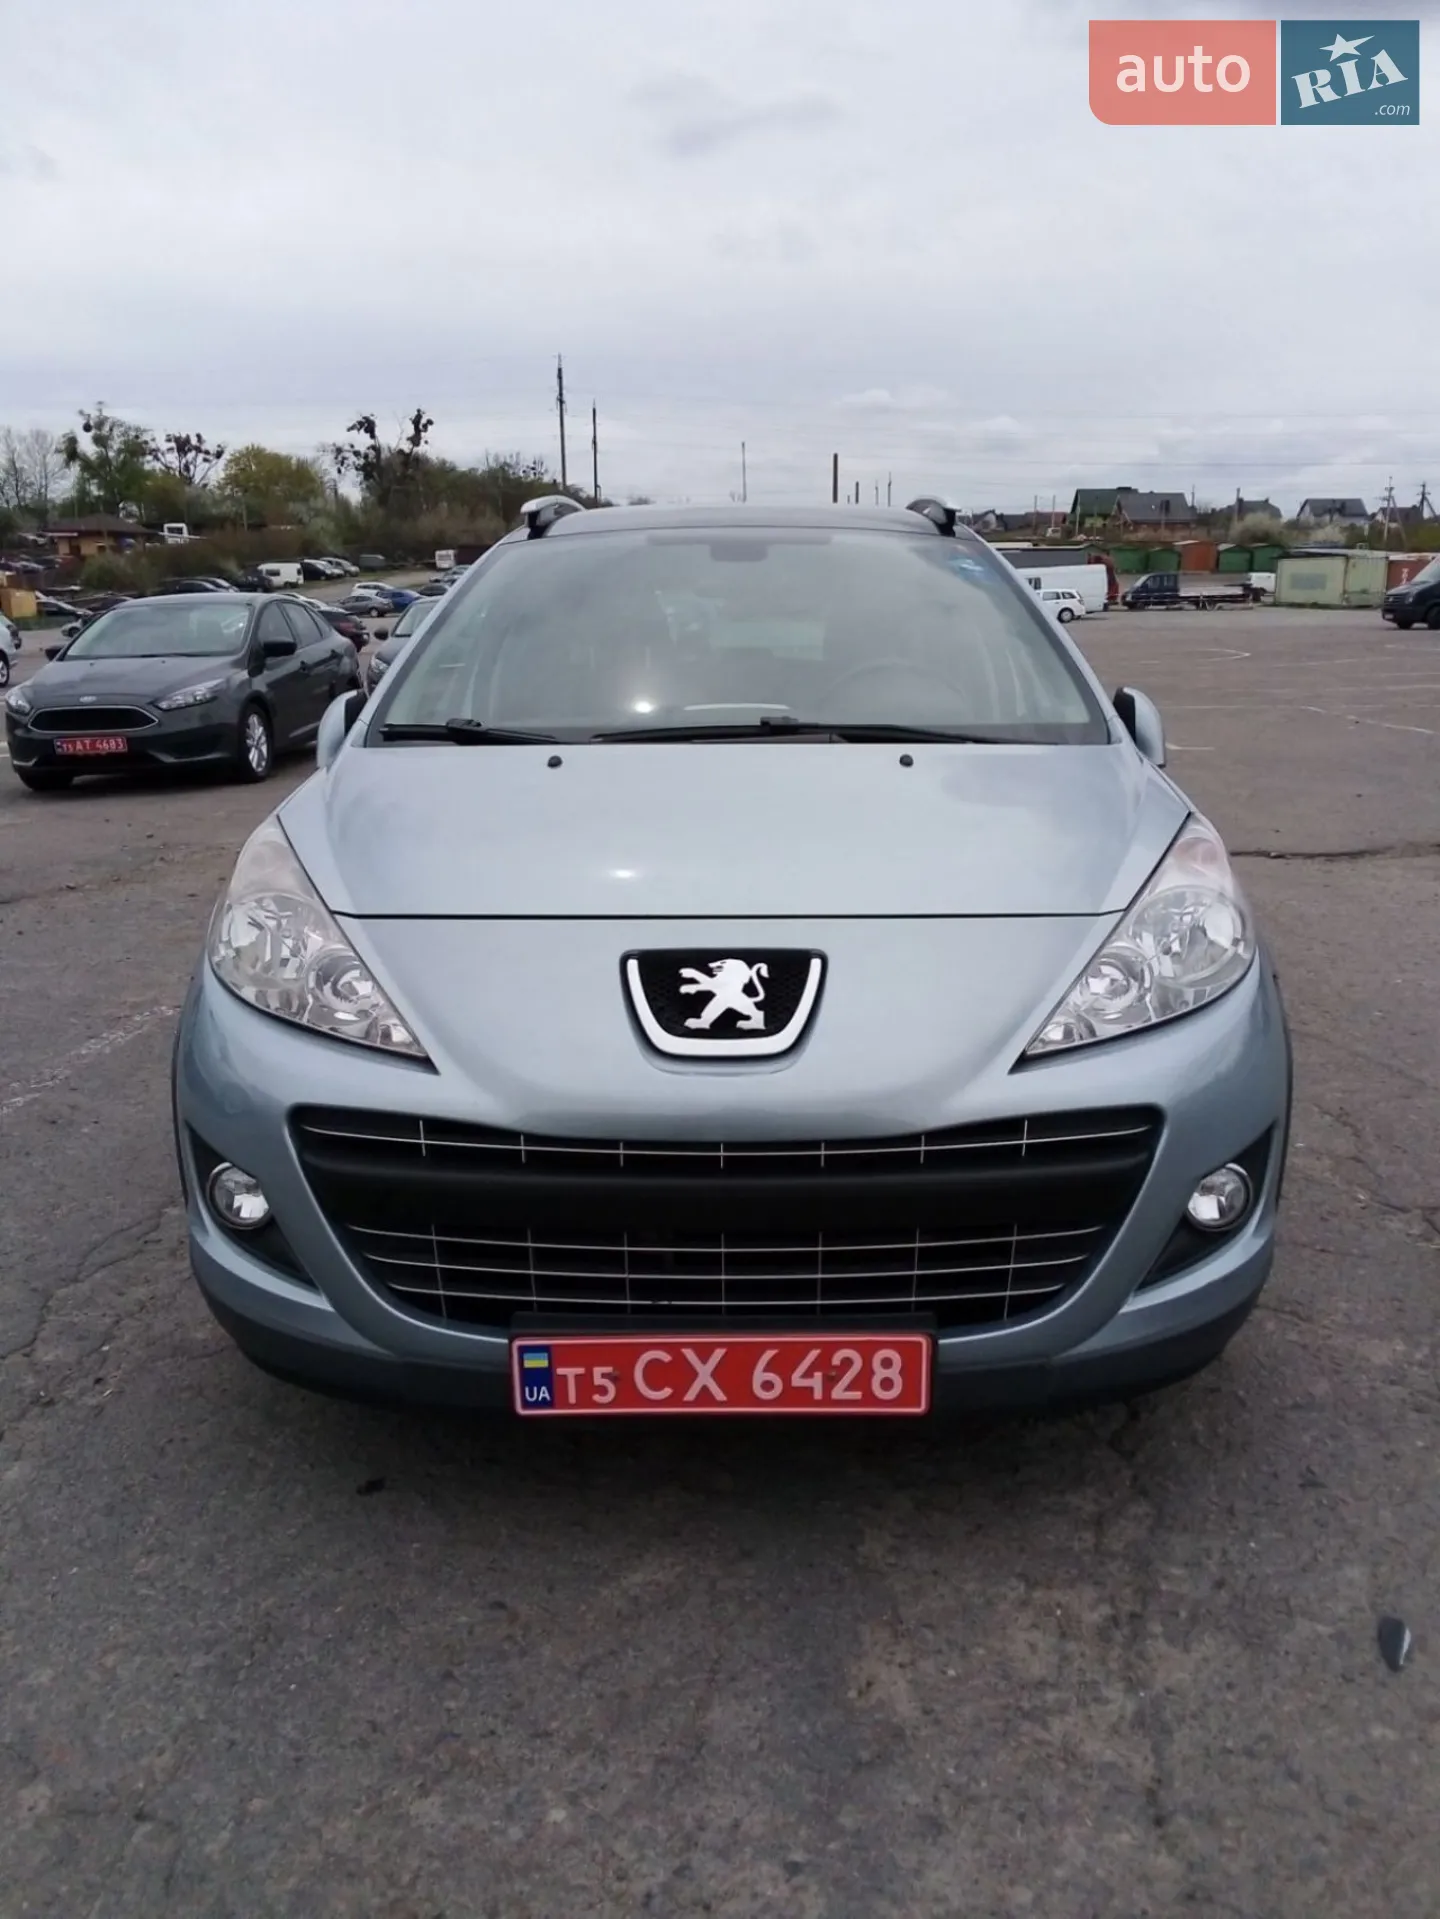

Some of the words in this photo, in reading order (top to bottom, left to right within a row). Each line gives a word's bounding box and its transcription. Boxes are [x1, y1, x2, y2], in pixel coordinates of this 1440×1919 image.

[525, 1386, 550, 1402] UA
[556, 1366, 616, 1404] T5
[633, 1348, 728, 1401] CX
[752, 1348, 903, 1401] 6428
